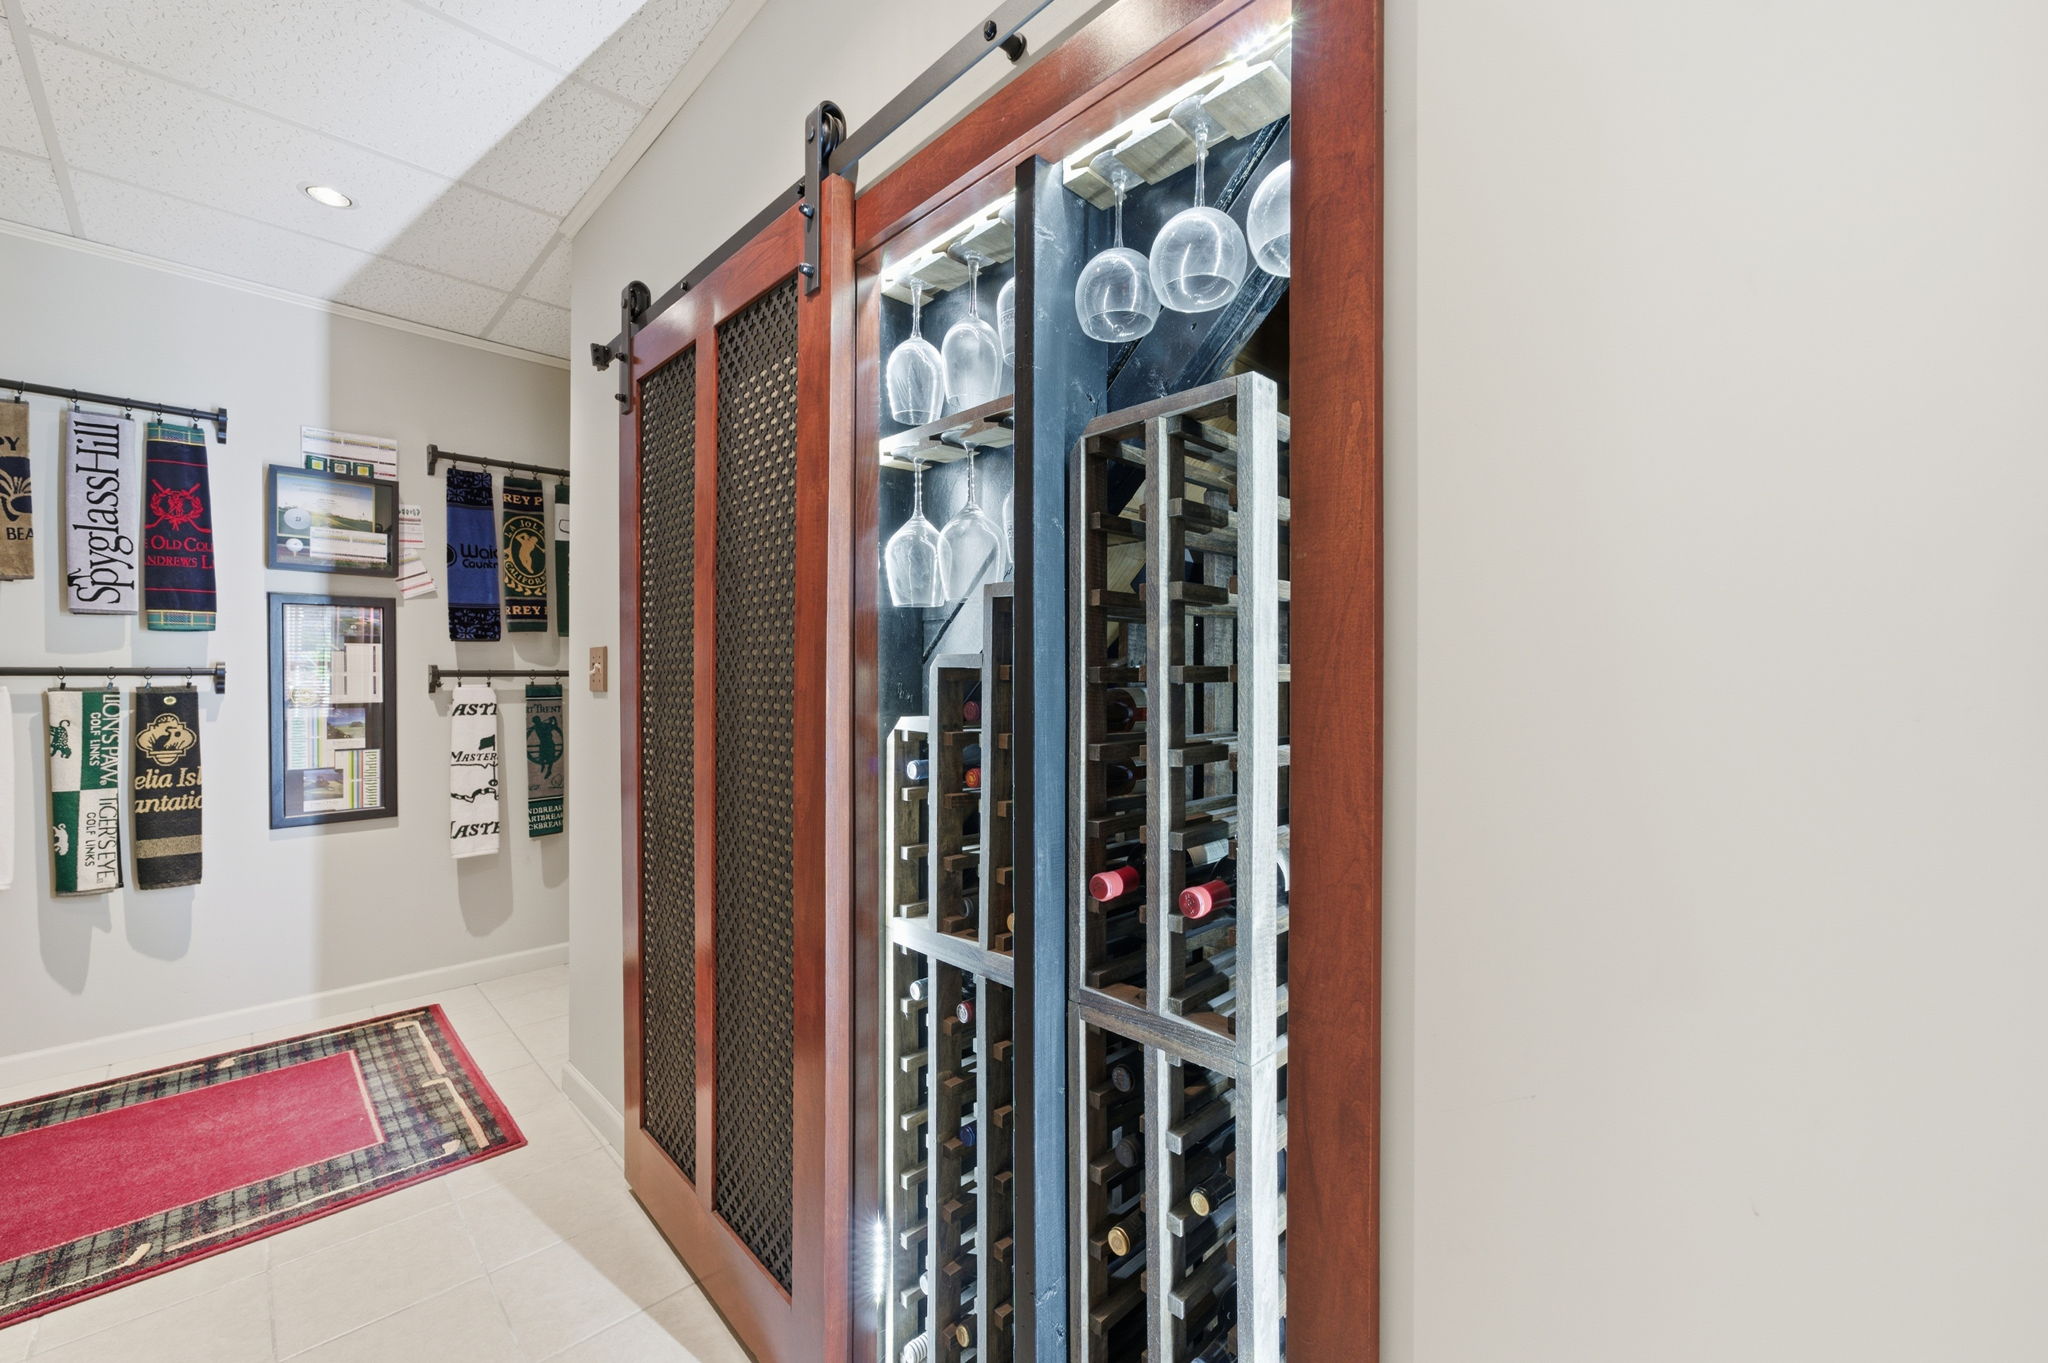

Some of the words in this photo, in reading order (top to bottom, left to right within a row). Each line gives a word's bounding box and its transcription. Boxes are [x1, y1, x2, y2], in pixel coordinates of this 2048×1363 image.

[151, 534, 182, 550] OLD
[144, 555, 198, 568] NDREWS
[89, 712, 101, 736] GOLF
[89, 740, 101, 767] LINKS
[451, 751, 498, 762] MASTER
[86, 812, 97, 836] GOLF
[84, 840, 96, 867] LINKS
